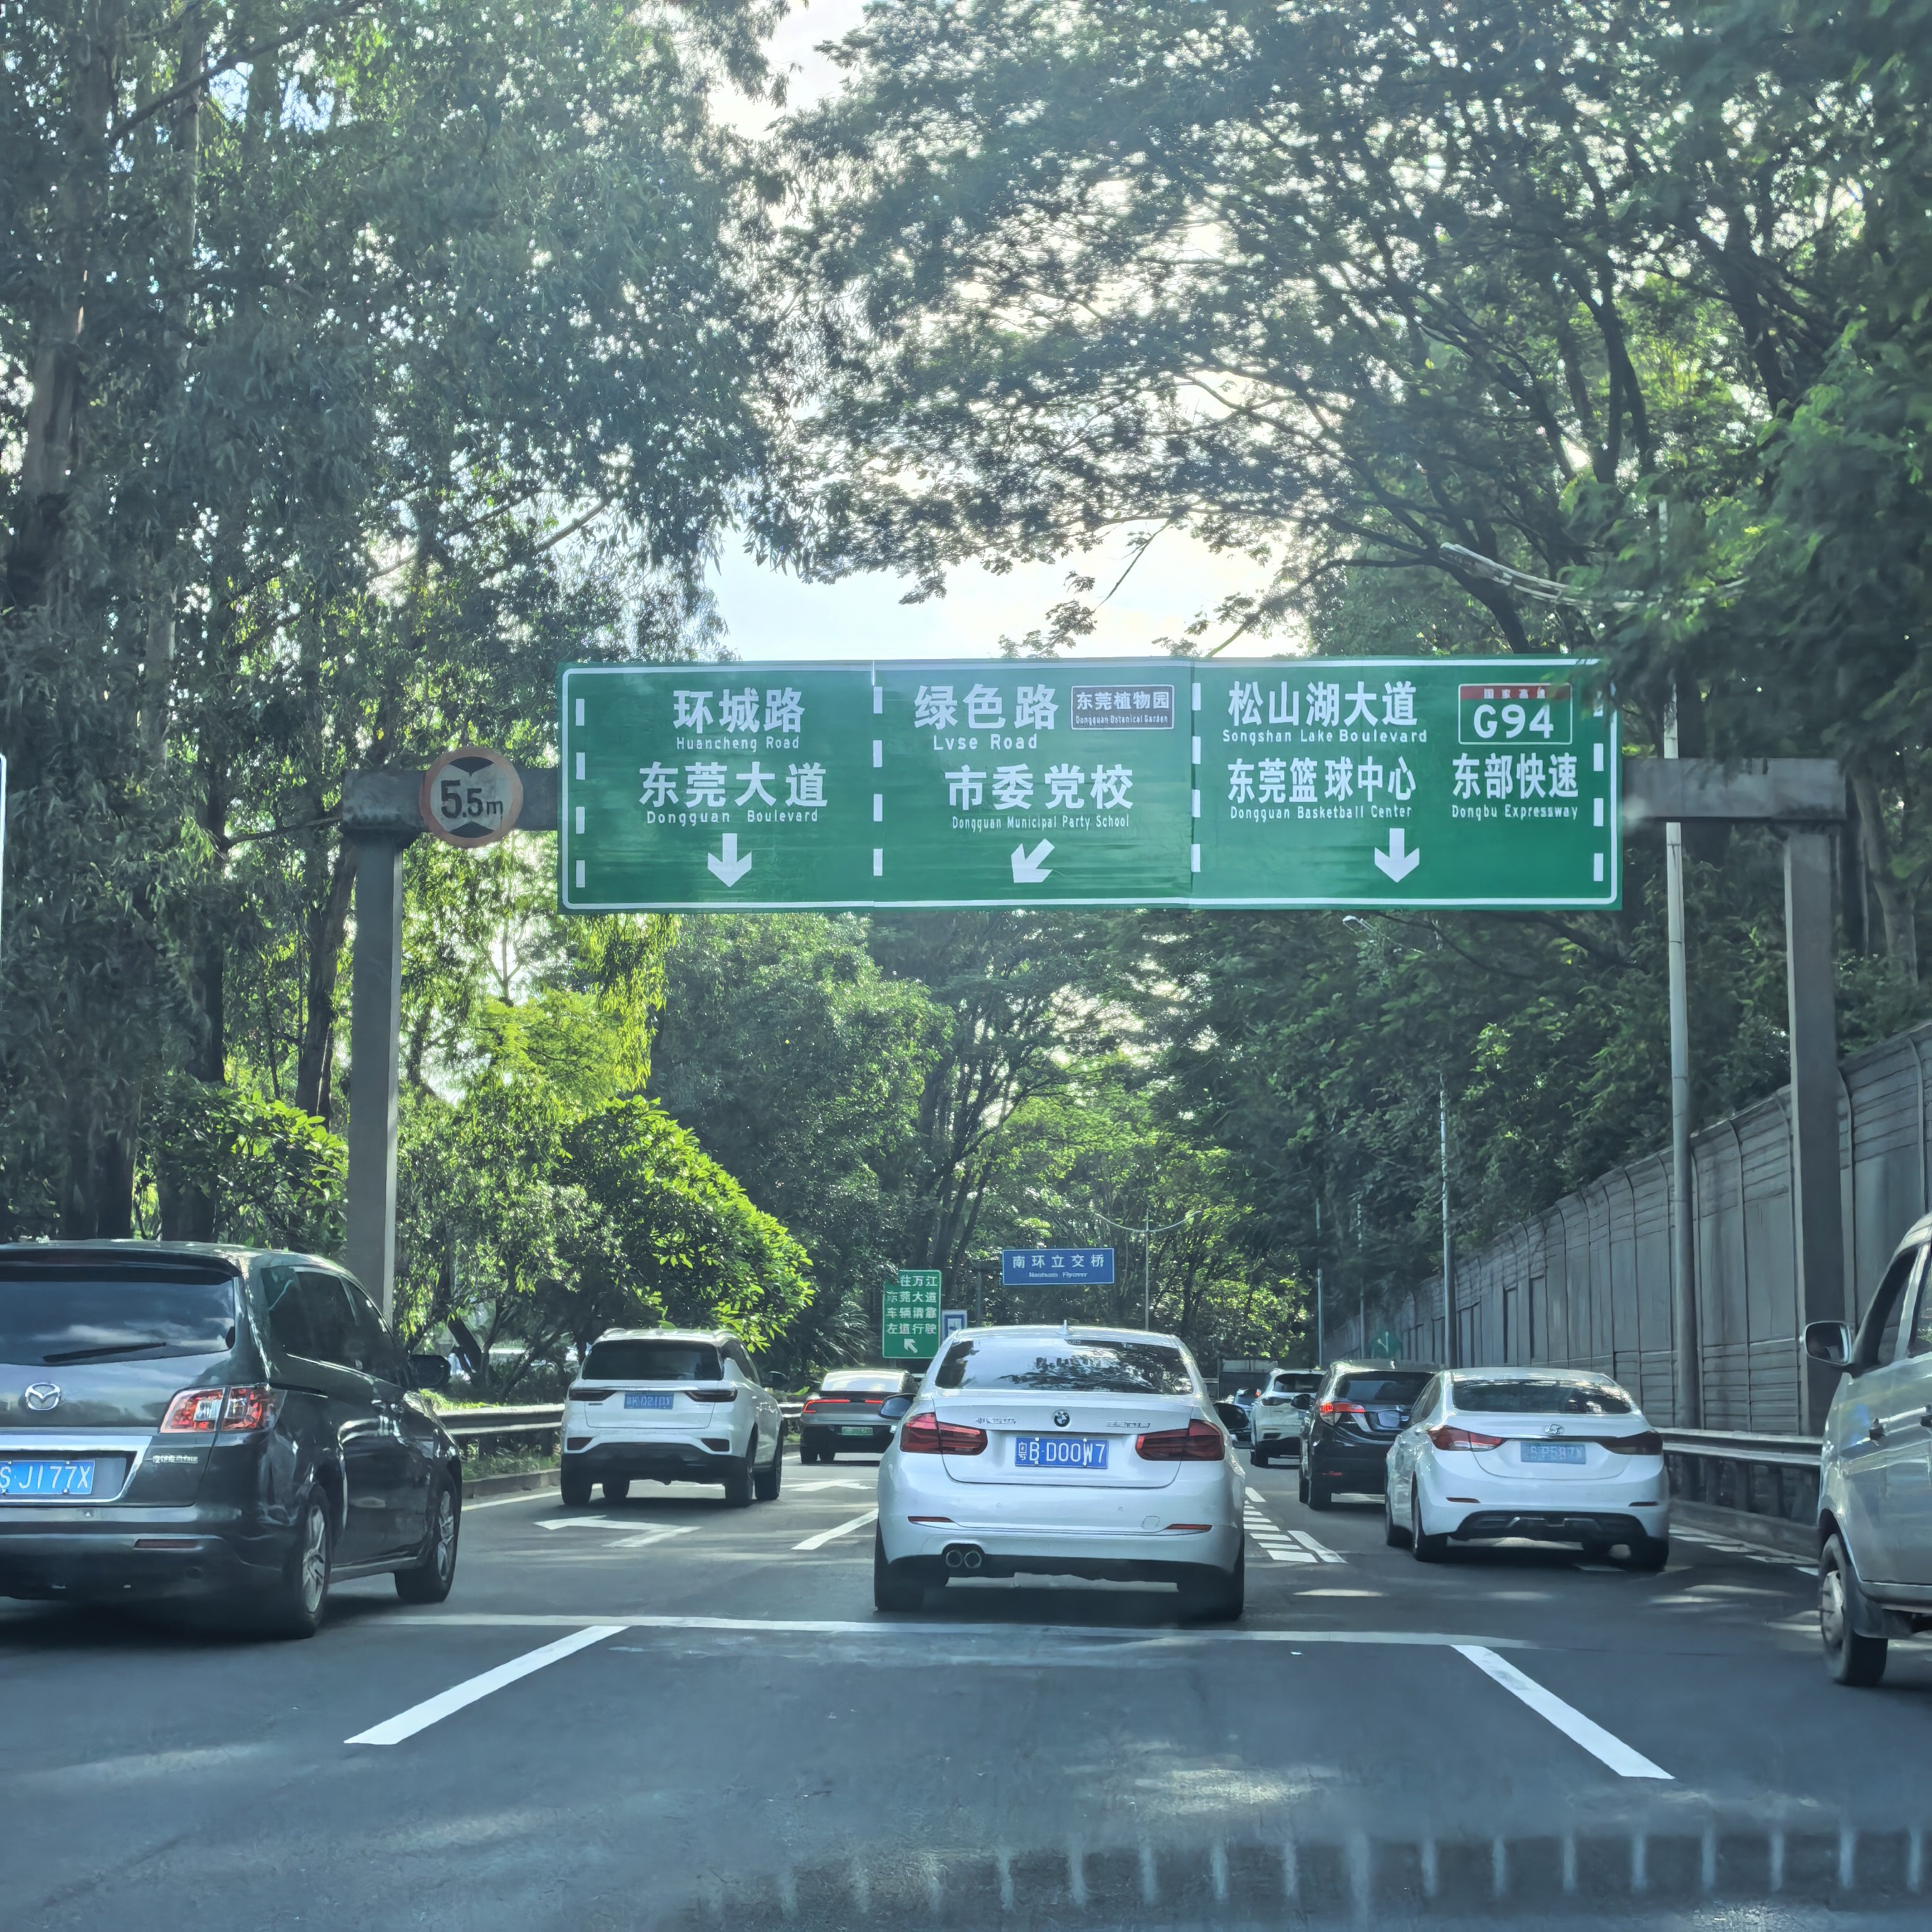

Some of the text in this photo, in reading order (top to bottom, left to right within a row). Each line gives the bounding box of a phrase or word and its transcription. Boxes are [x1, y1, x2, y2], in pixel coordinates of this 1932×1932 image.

[674, 687, 805, 733] 环城路
[914, 684, 1059, 730] 绿色路
[1077, 691, 1169, 710] 东莞植物园
[1228, 681, 1417, 727] 松山湖大道
[1474, 704, 1553, 738] G94
[677, 736, 799, 752] Huancheng Road
[934, 733, 1036, 750] Lvse Road
[1223, 730, 1426, 746] Songshan Lake Boulevard
[639, 762, 827, 808] 东莞大道
[945, 763, 1133, 810] 市委党校
[1228, 756, 1416, 803] 东莞篮球中心
[1453, 753, 1578, 799] 东部快速
[440, 779, 503, 818] 5.5m
[647, 809, 817, 826] Dongguan Boulevard
[953, 814, 1128, 833] Dongguan Municipal Party School
[1231, 804, 1411, 823] Dongguan Basketball Center
[1452, 804, 1577, 821] Dongbu Expressway
[1013, 1254, 1104, 1268] 南环立交桥
